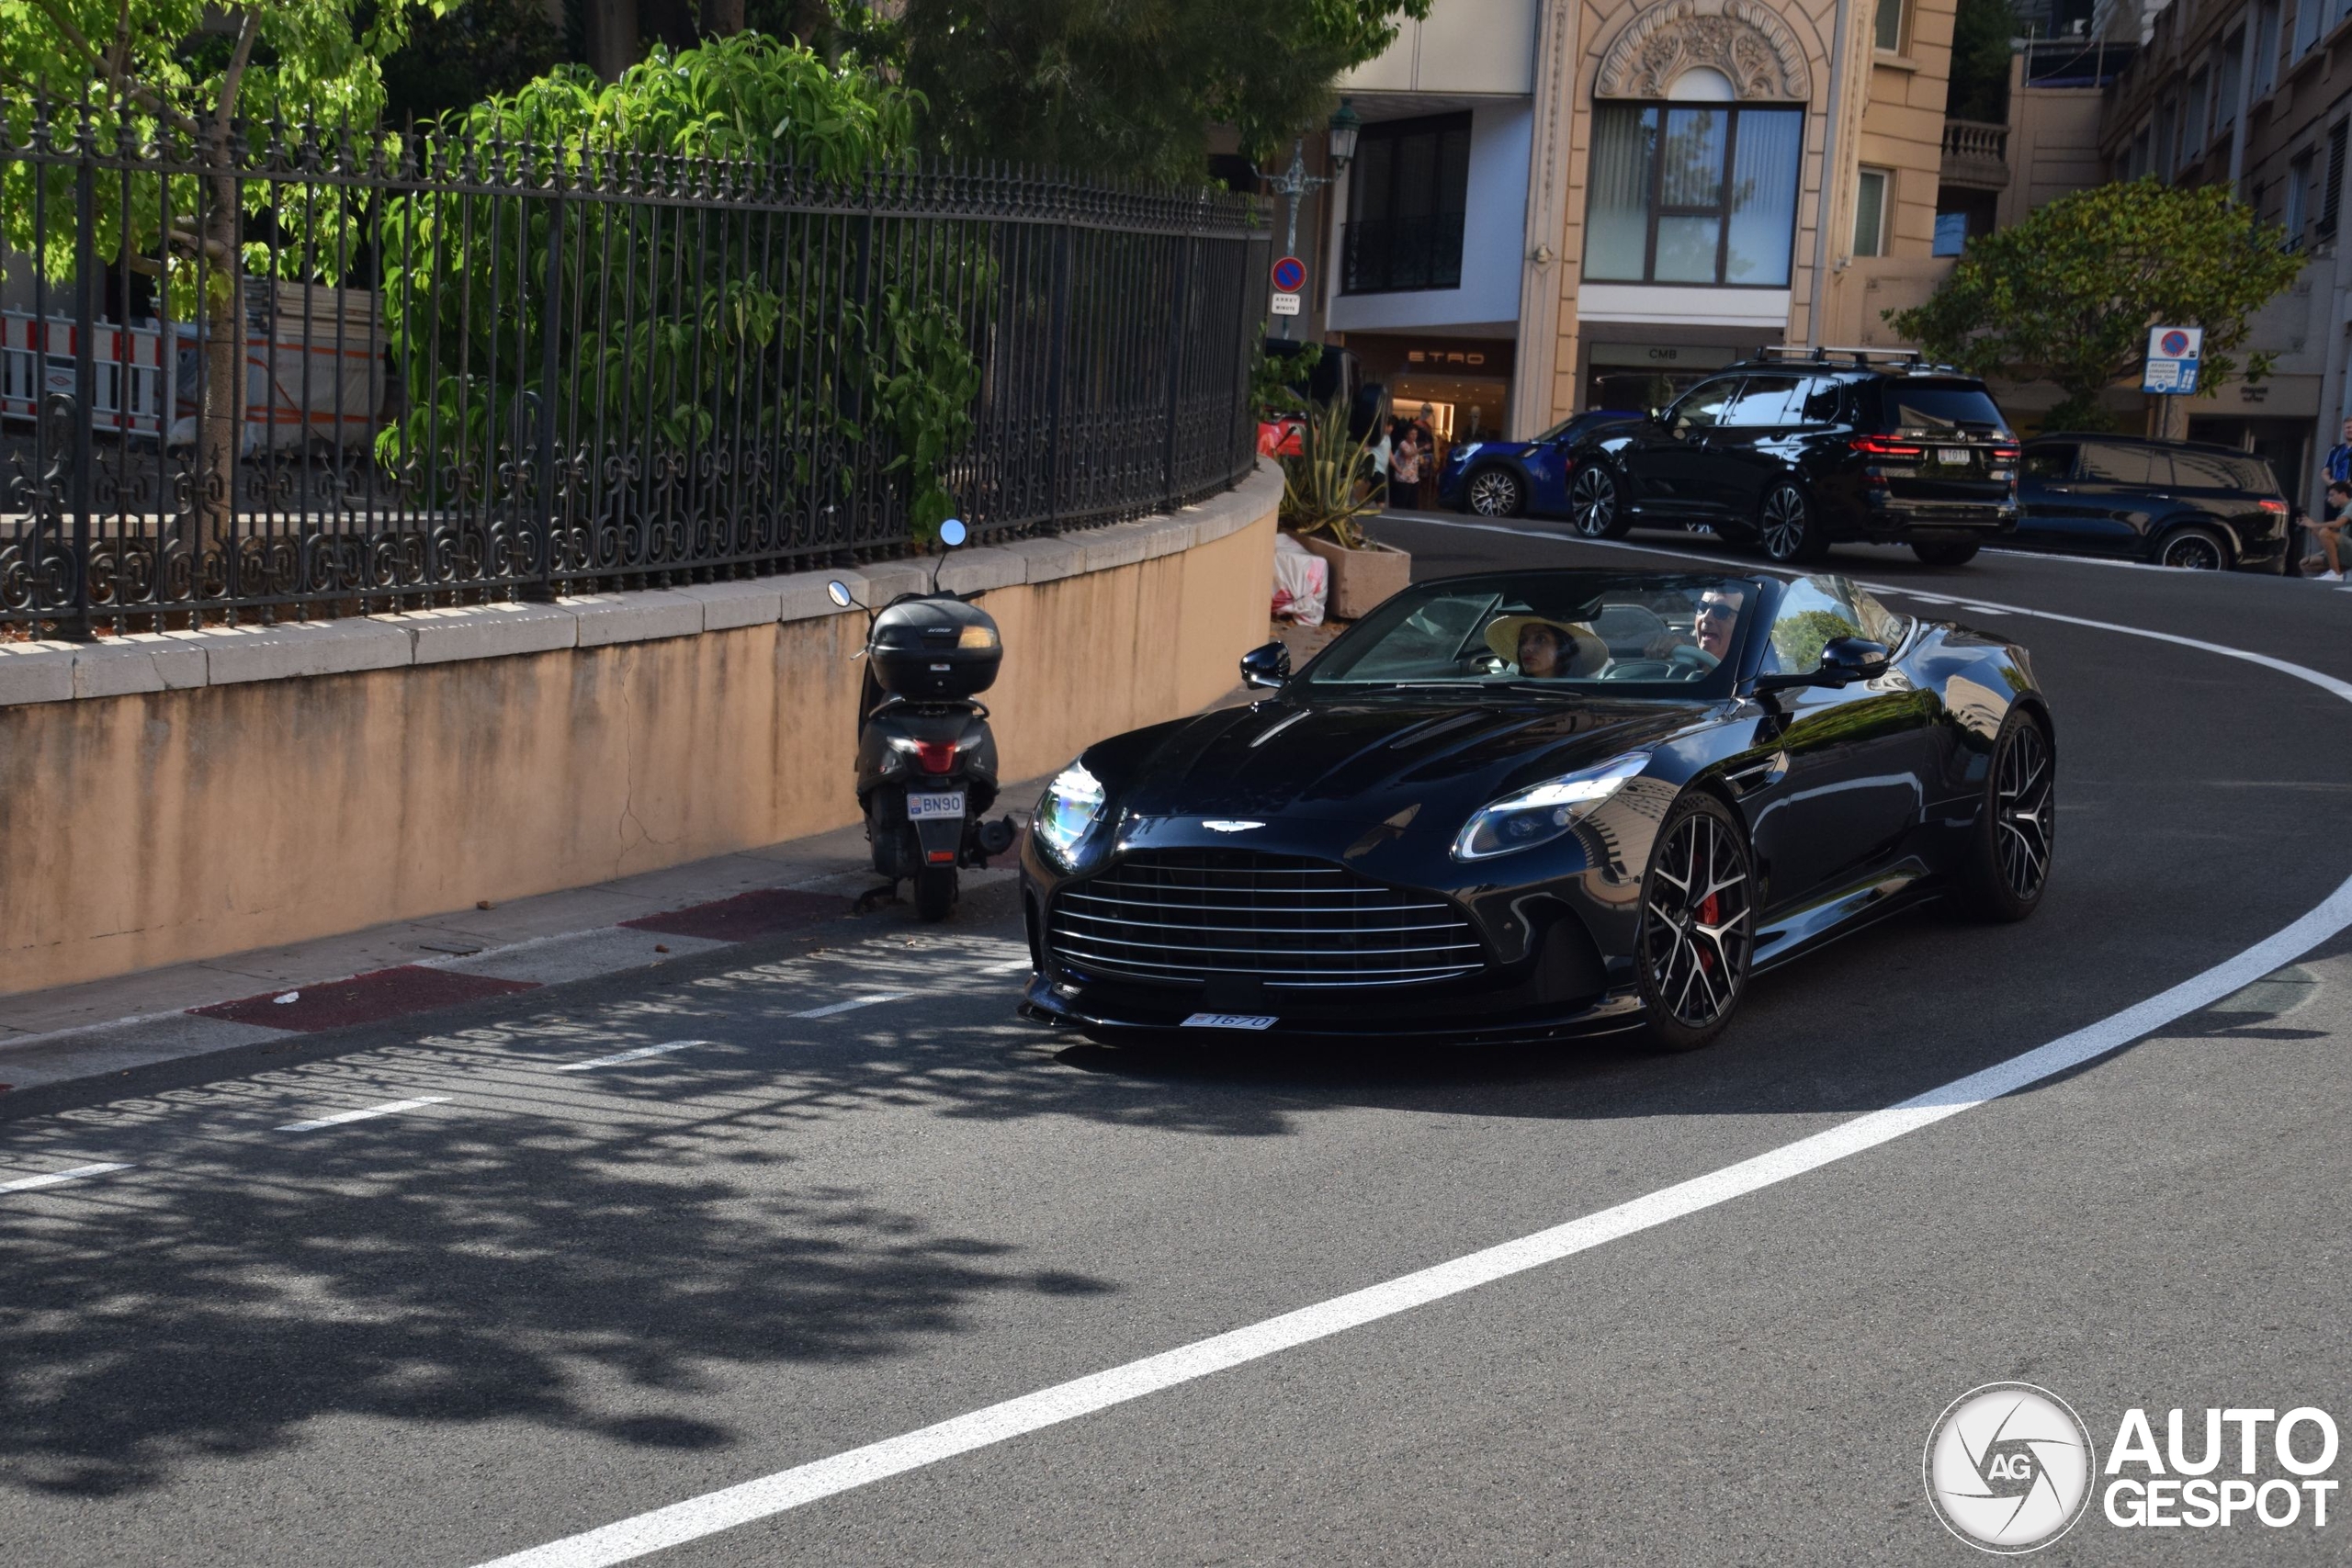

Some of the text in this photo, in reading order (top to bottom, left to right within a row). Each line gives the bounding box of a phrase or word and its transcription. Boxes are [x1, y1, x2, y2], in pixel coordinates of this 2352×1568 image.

[1408, 351, 1485, 365] ETRO
[1649, 348, 1677, 359] CMB
[923, 796, 961, 812] BN90
[1210, 1015, 1271, 1027] 1670
